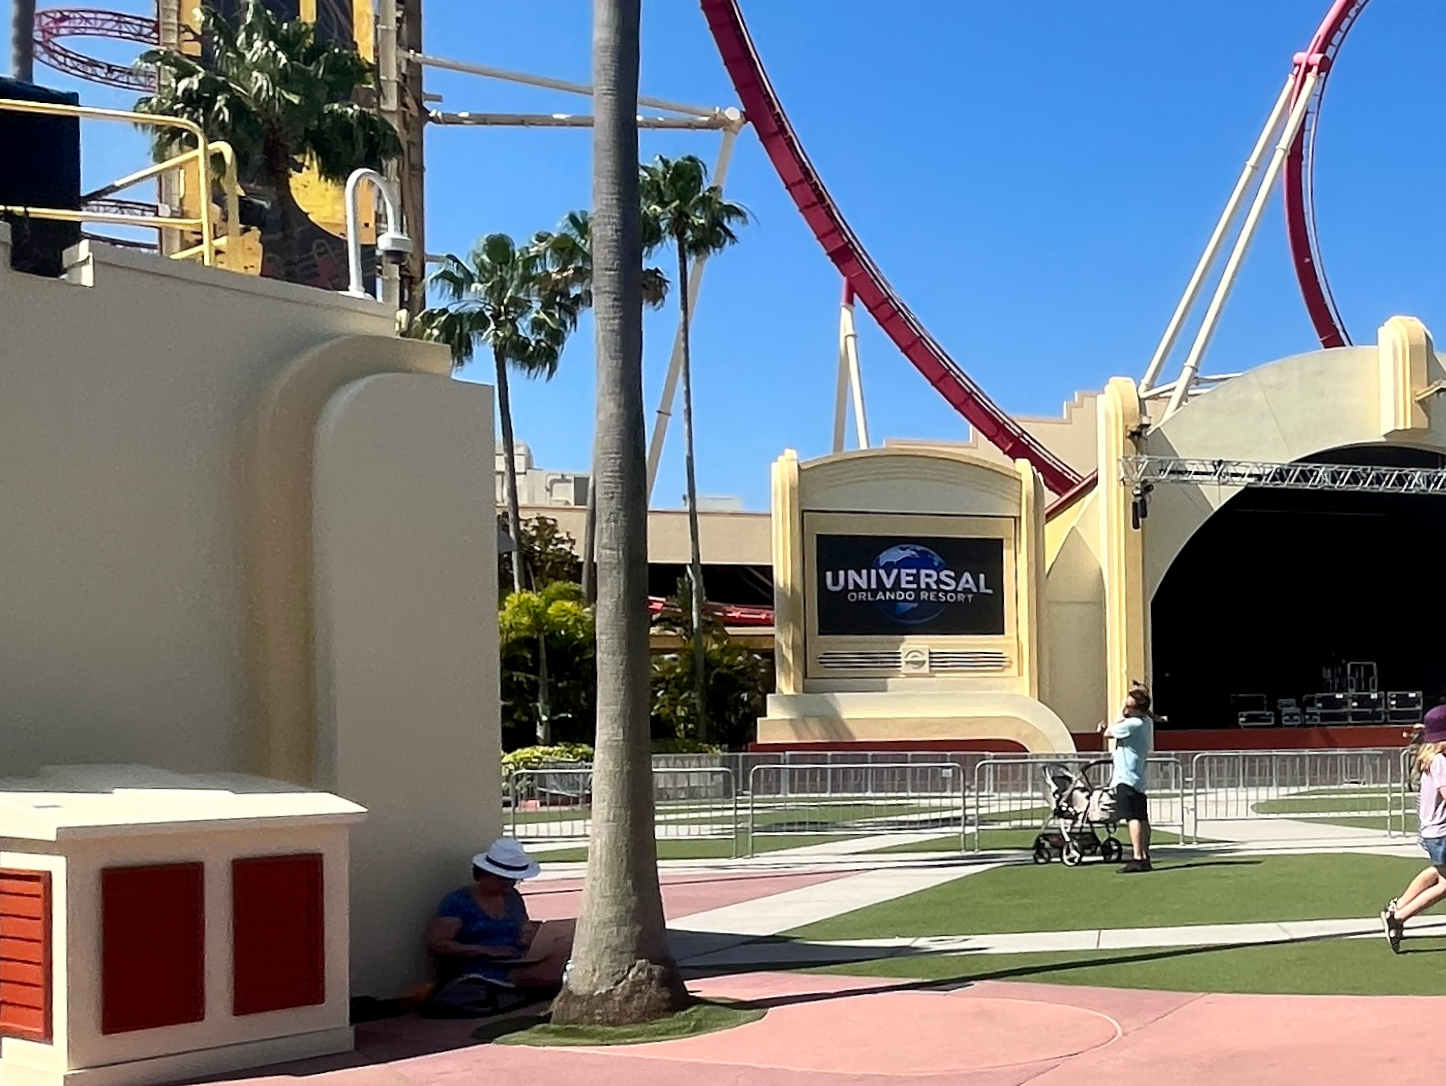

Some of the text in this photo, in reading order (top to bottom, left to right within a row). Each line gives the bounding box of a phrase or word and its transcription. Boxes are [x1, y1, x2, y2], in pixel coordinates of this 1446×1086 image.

[825, 568, 994, 594] UNIVERSAL
[847, 590, 974, 603] ORLANDO RESORT
